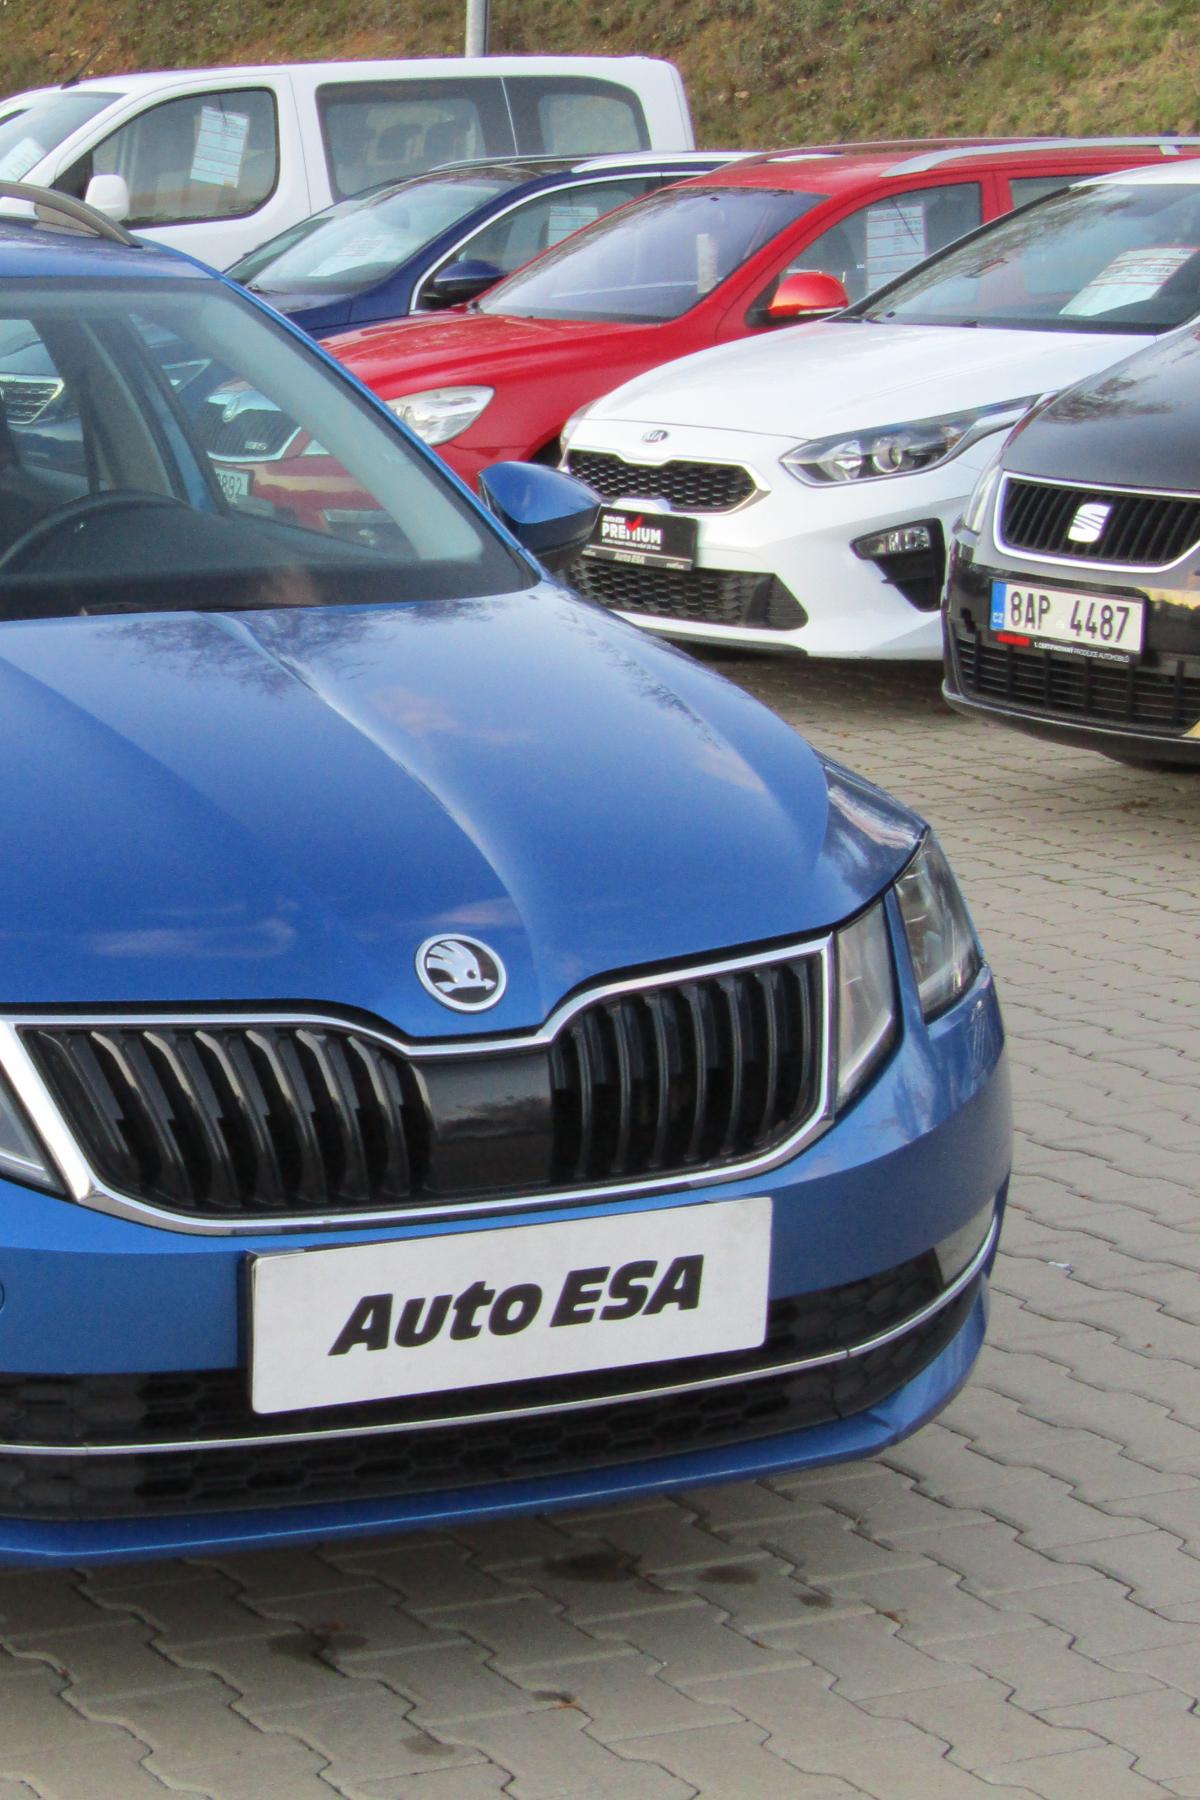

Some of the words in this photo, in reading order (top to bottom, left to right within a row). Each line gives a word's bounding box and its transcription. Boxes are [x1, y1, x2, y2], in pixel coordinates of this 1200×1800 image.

[1010, 591, 1050, 630] 8AP
[1069, 600, 1130, 643] 4487
[327, 1281, 543, 1356] Auto
[549, 1254, 705, 1328] ESA
